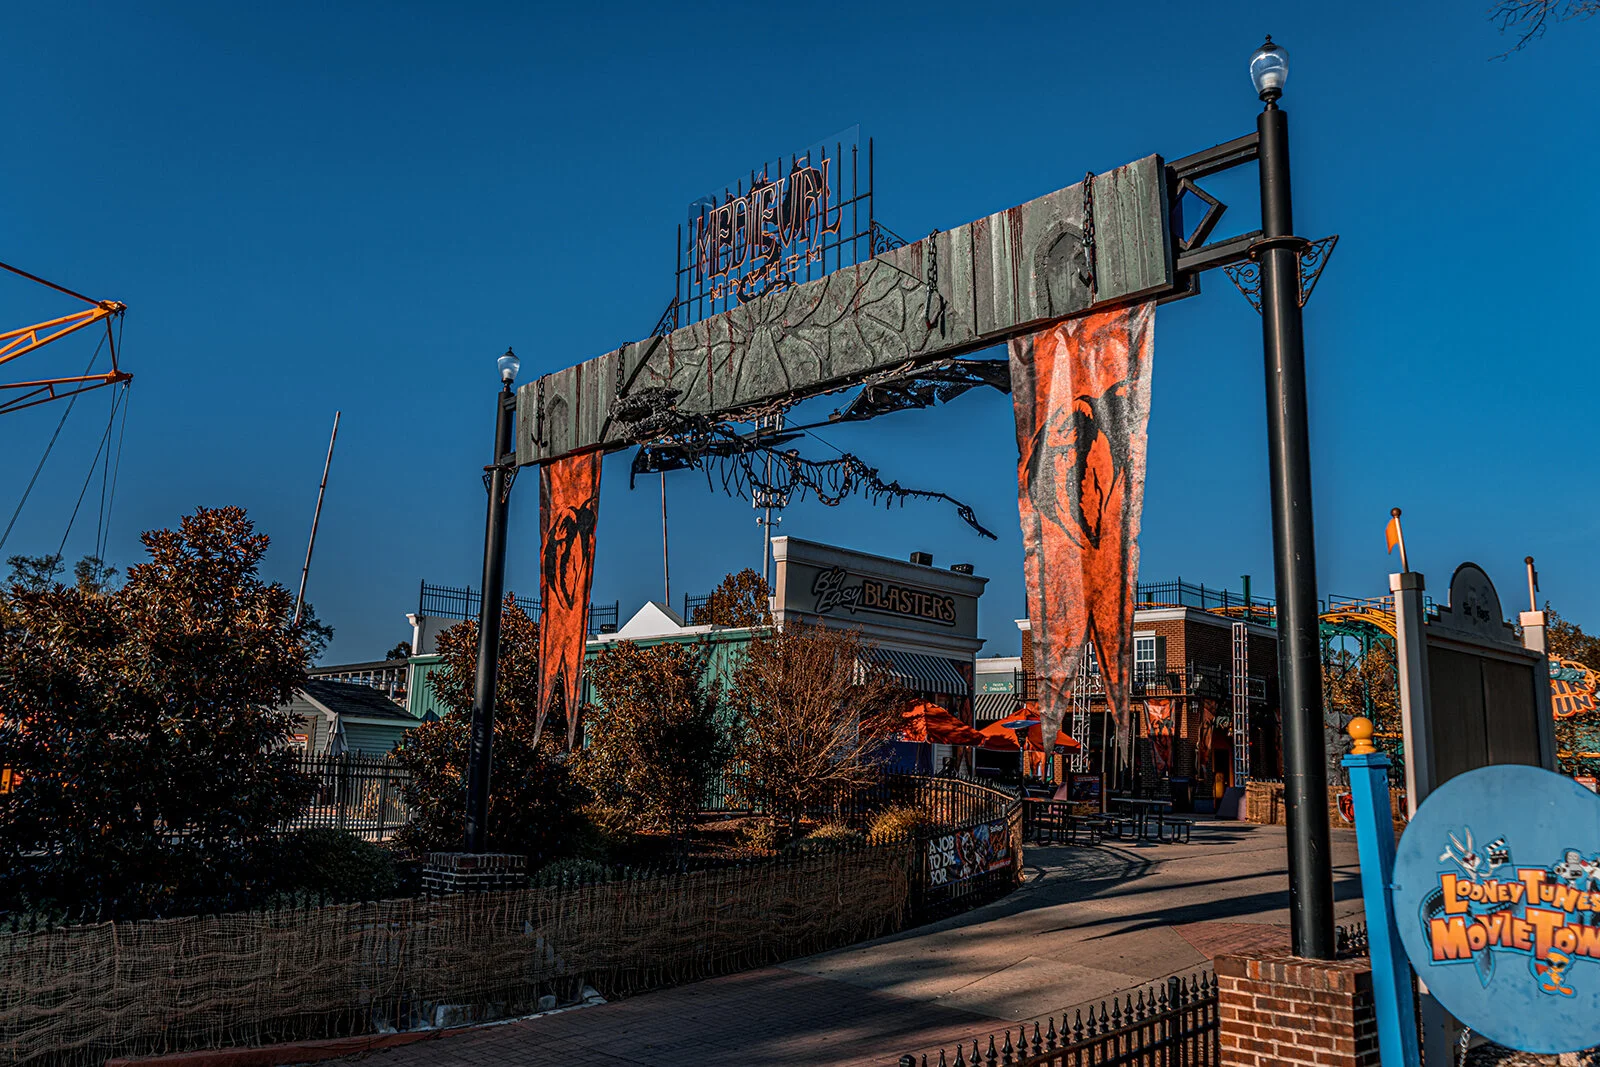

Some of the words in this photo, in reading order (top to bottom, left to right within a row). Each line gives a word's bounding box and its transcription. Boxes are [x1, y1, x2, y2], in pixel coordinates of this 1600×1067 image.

[694, 157, 842, 285] MEDIEVAL
[709, 245, 823, 303] MAYHEM
[814, 568, 847, 593] Big
[815, 586, 863, 614] Easy
[864, 582, 955, 622] BLASTERS
[929, 839, 937, 855] A
[938, 835, 955, 852] JOB
[929, 854, 941, 871] TO
[942, 850, 957, 868] DIE
[930, 869, 948, 886] FOR
[1441, 873, 1525, 914] LOONEY
[1517, 868, 1600, 914] TUNES
